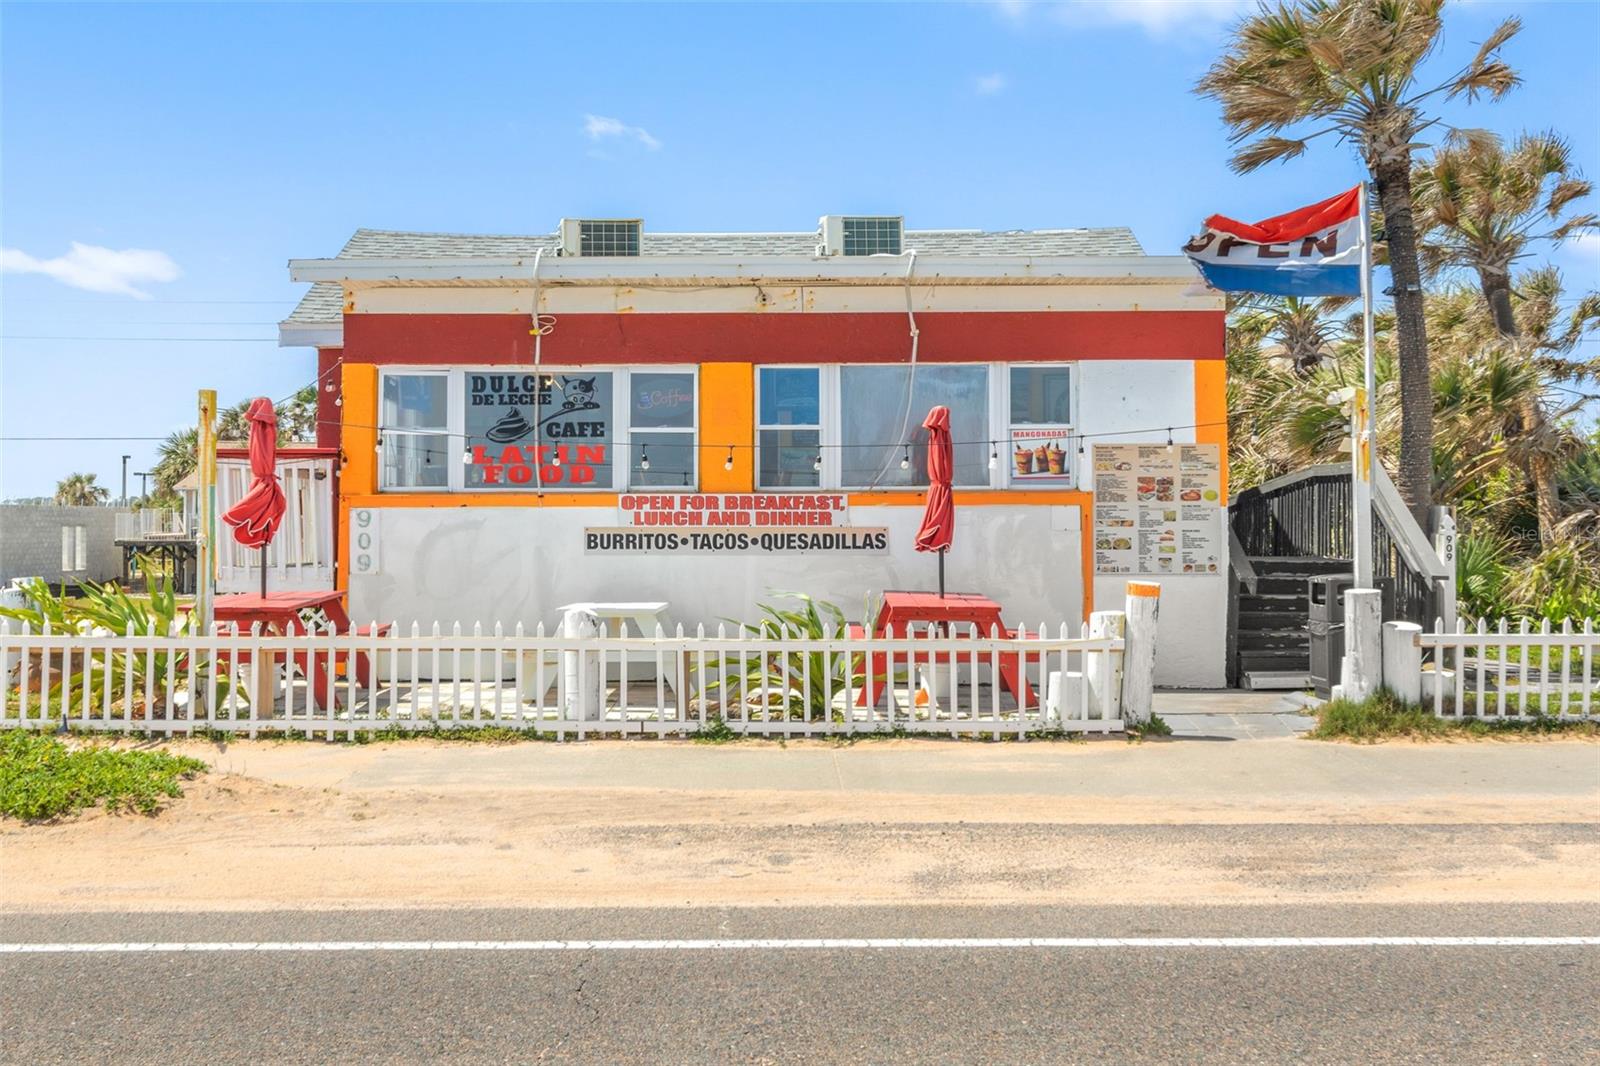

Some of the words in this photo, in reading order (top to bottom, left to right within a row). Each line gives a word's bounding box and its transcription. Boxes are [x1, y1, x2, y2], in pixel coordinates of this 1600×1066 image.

[472, 375, 552, 393] DULCE
[472, 394, 495, 406] DE
[498, 394, 552, 406] LECHE
[546, 421, 605, 438] CAFE
[1013, 430, 1067, 438] MANGONADAS
[472, 444, 606, 465] LATIN
[483, 465, 595, 484] FOOD
[621, 495, 675, 510] OPEN
[680, 495, 719, 510] FOR
[724, 495, 846, 511] BREAKFAST,
[634, 511, 702, 526] LUNCH
[707, 511, 751, 526] AND
[756, 511, 832, 526] DINNER
[357, 510, 372, 572] 909
